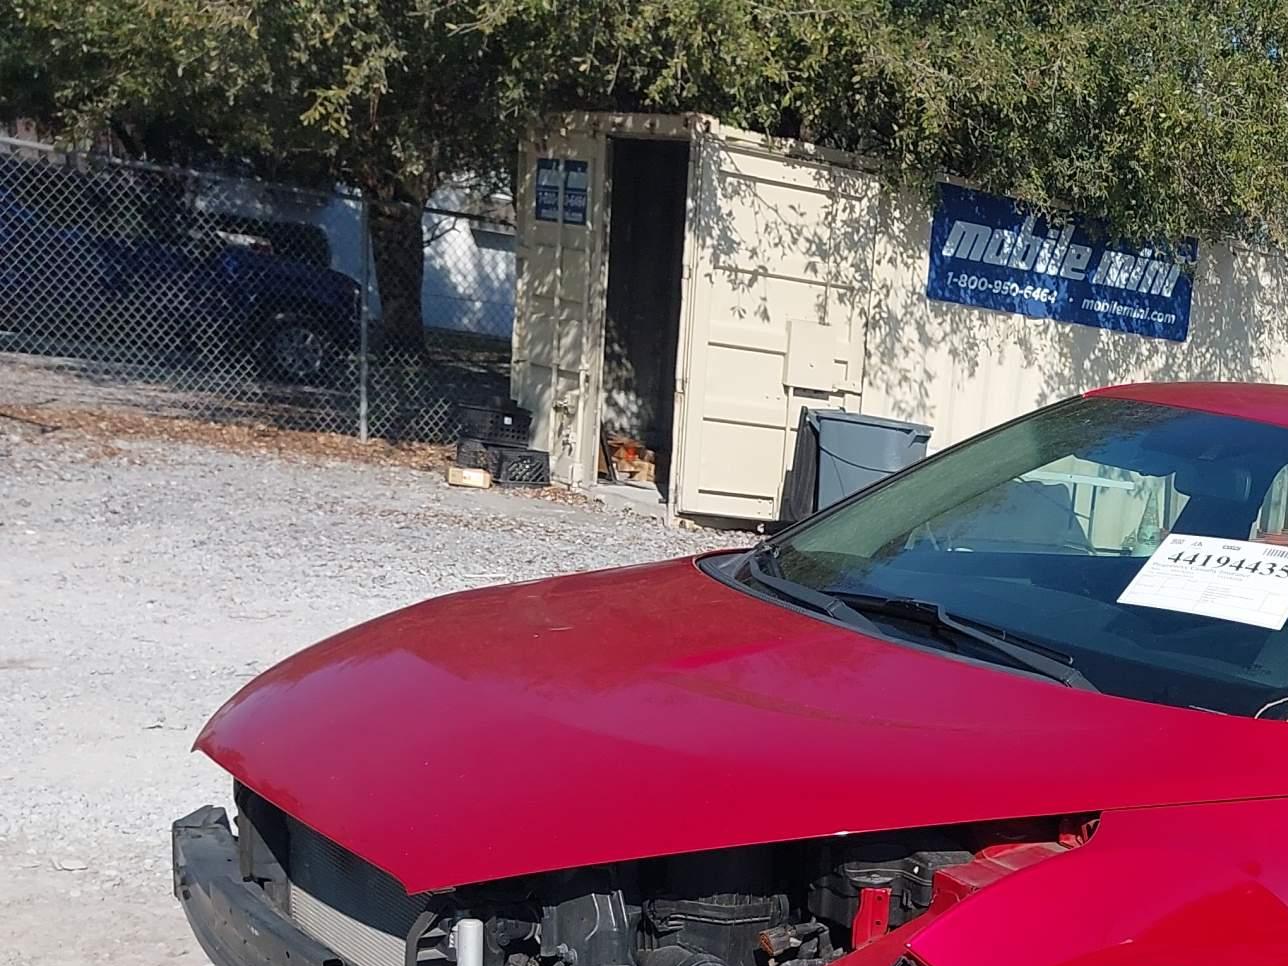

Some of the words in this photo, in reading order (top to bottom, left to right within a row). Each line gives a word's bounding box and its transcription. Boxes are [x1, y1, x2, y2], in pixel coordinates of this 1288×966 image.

[942, 215, 1092, 281] mobile
[1092, 247, 1180, 297] mini
[946, 271, 1058, 304] 1-800-950-6464
[1081, 299, 1176, 325] mobilemini.com
